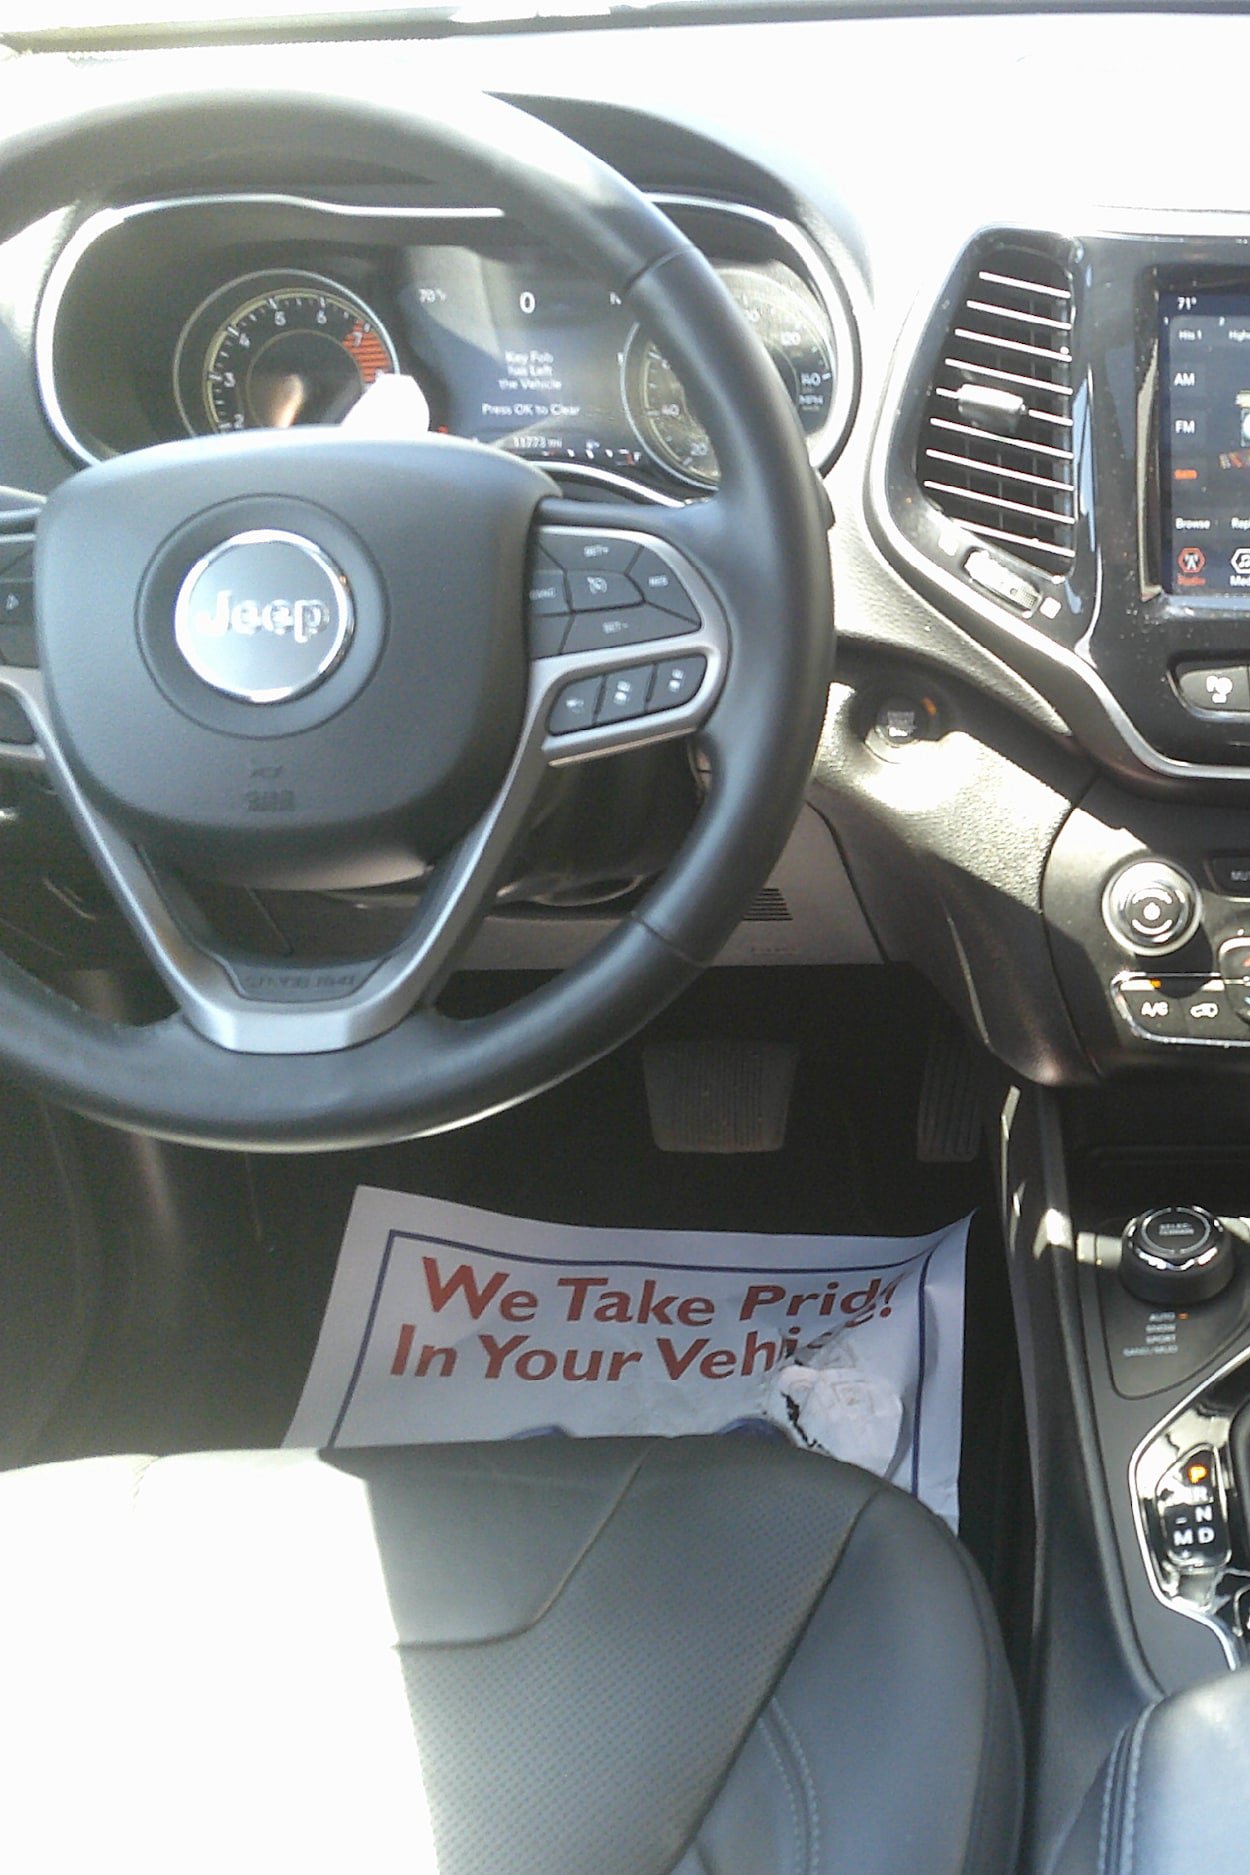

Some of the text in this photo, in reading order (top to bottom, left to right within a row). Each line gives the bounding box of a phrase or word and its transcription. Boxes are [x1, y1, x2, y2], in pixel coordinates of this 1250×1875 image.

[519, 291, 536, 314] 0
[274, 310, 286, 326] 5
[317, 309, 327, 325] 6
[223, 371, 235, 389] 3
[519, 377, 562, 390] Vehicle
[1174, 372, 1196, 387] AM
[482, 402, 580, 416] Press OK to Clear
[1175, 420, 1196, 434] FM
[1175, 516, 1211, 530] Browse
[193, 589, 331, 644] Jeep
[421, 1256, 539, 1323] We
[556, 1277, 716, 1327] Take
[390, 1324, 457, 1378] In
[477, 1333, 643, 1382] Your
[1188, 1465, 1207, 1484] P
[1195, 1504, 1213, 1523] N
[1173, 1526, 1215, 1547] M D
